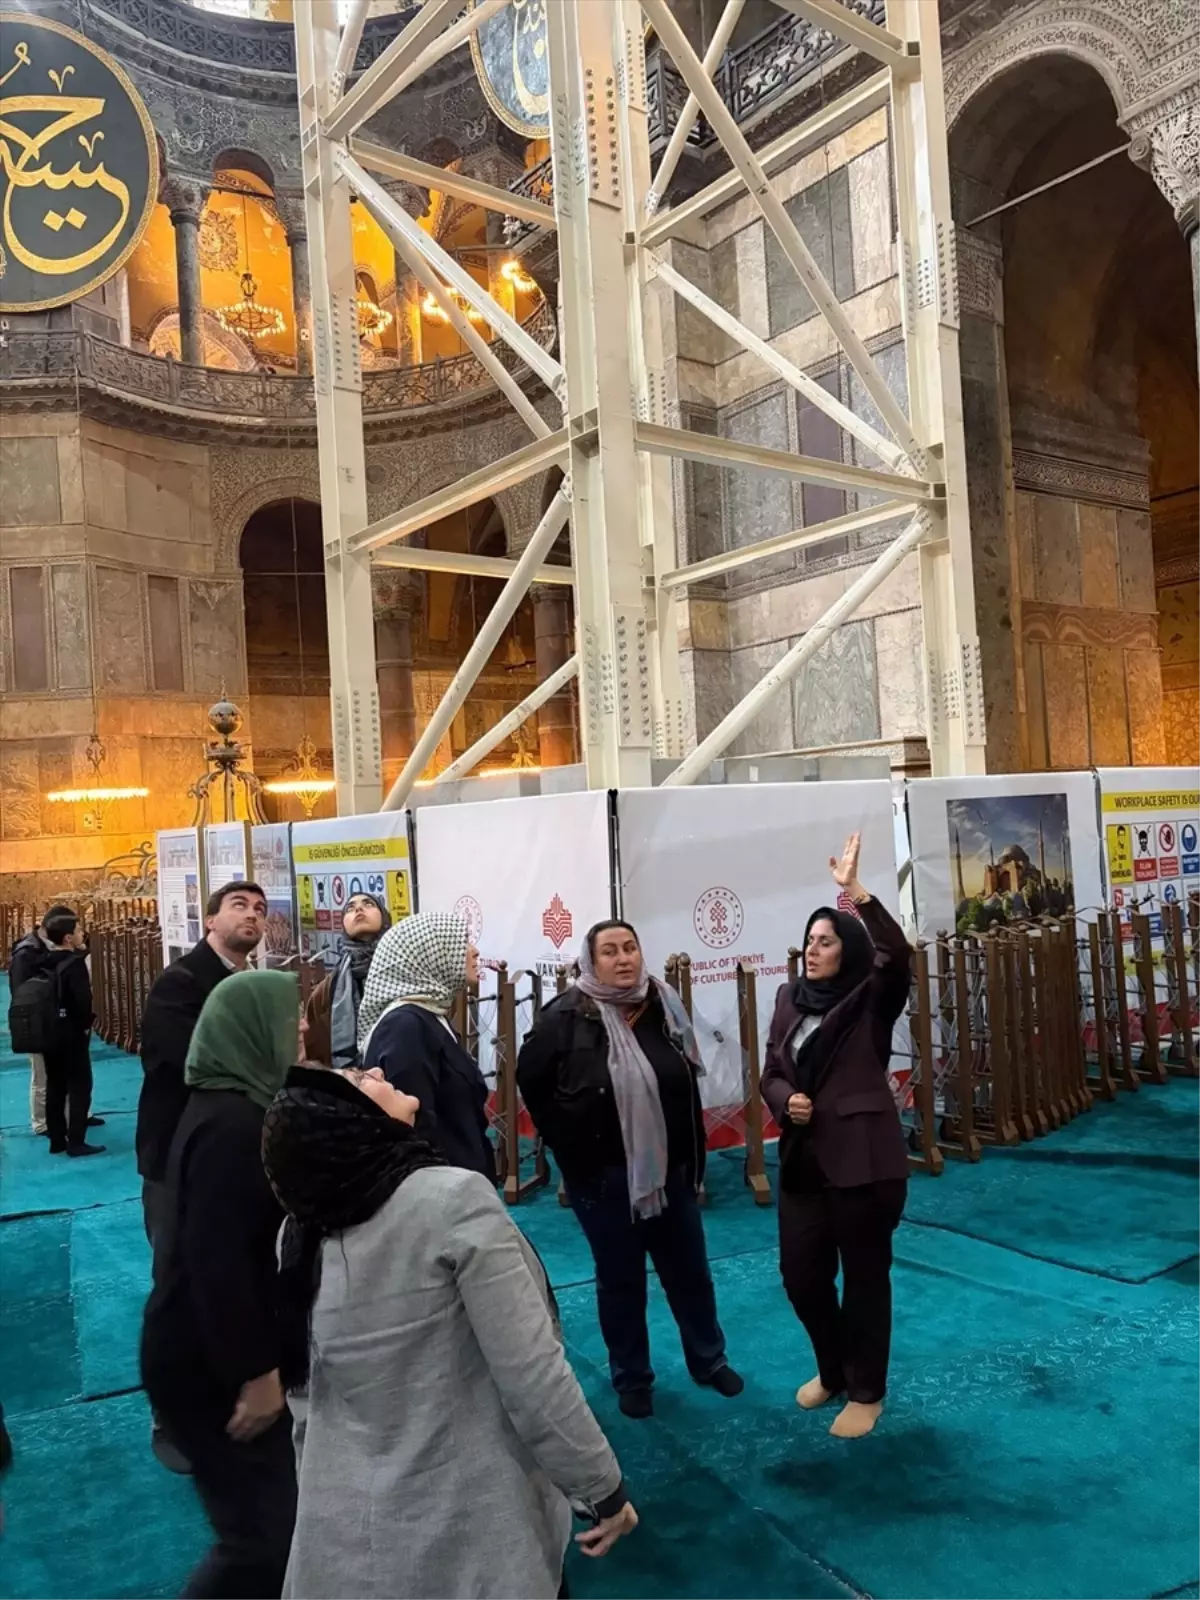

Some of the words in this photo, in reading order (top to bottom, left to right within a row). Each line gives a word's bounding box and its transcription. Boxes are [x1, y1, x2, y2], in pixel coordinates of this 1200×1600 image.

[1114, 795, 1156, 808] WORKPLACE
[1157, 794, 1181, 807] SAFETY
[1182, 794, 1188, 805] IS
[691, 959, 717, 972] UBLIC
[719, 956, 729, 969] OF
[732, 953, 765, 967] TÜRKİYE
[701, 971, 738, 984] CULTURE
[761, 965, 790, 977] TOURIS
